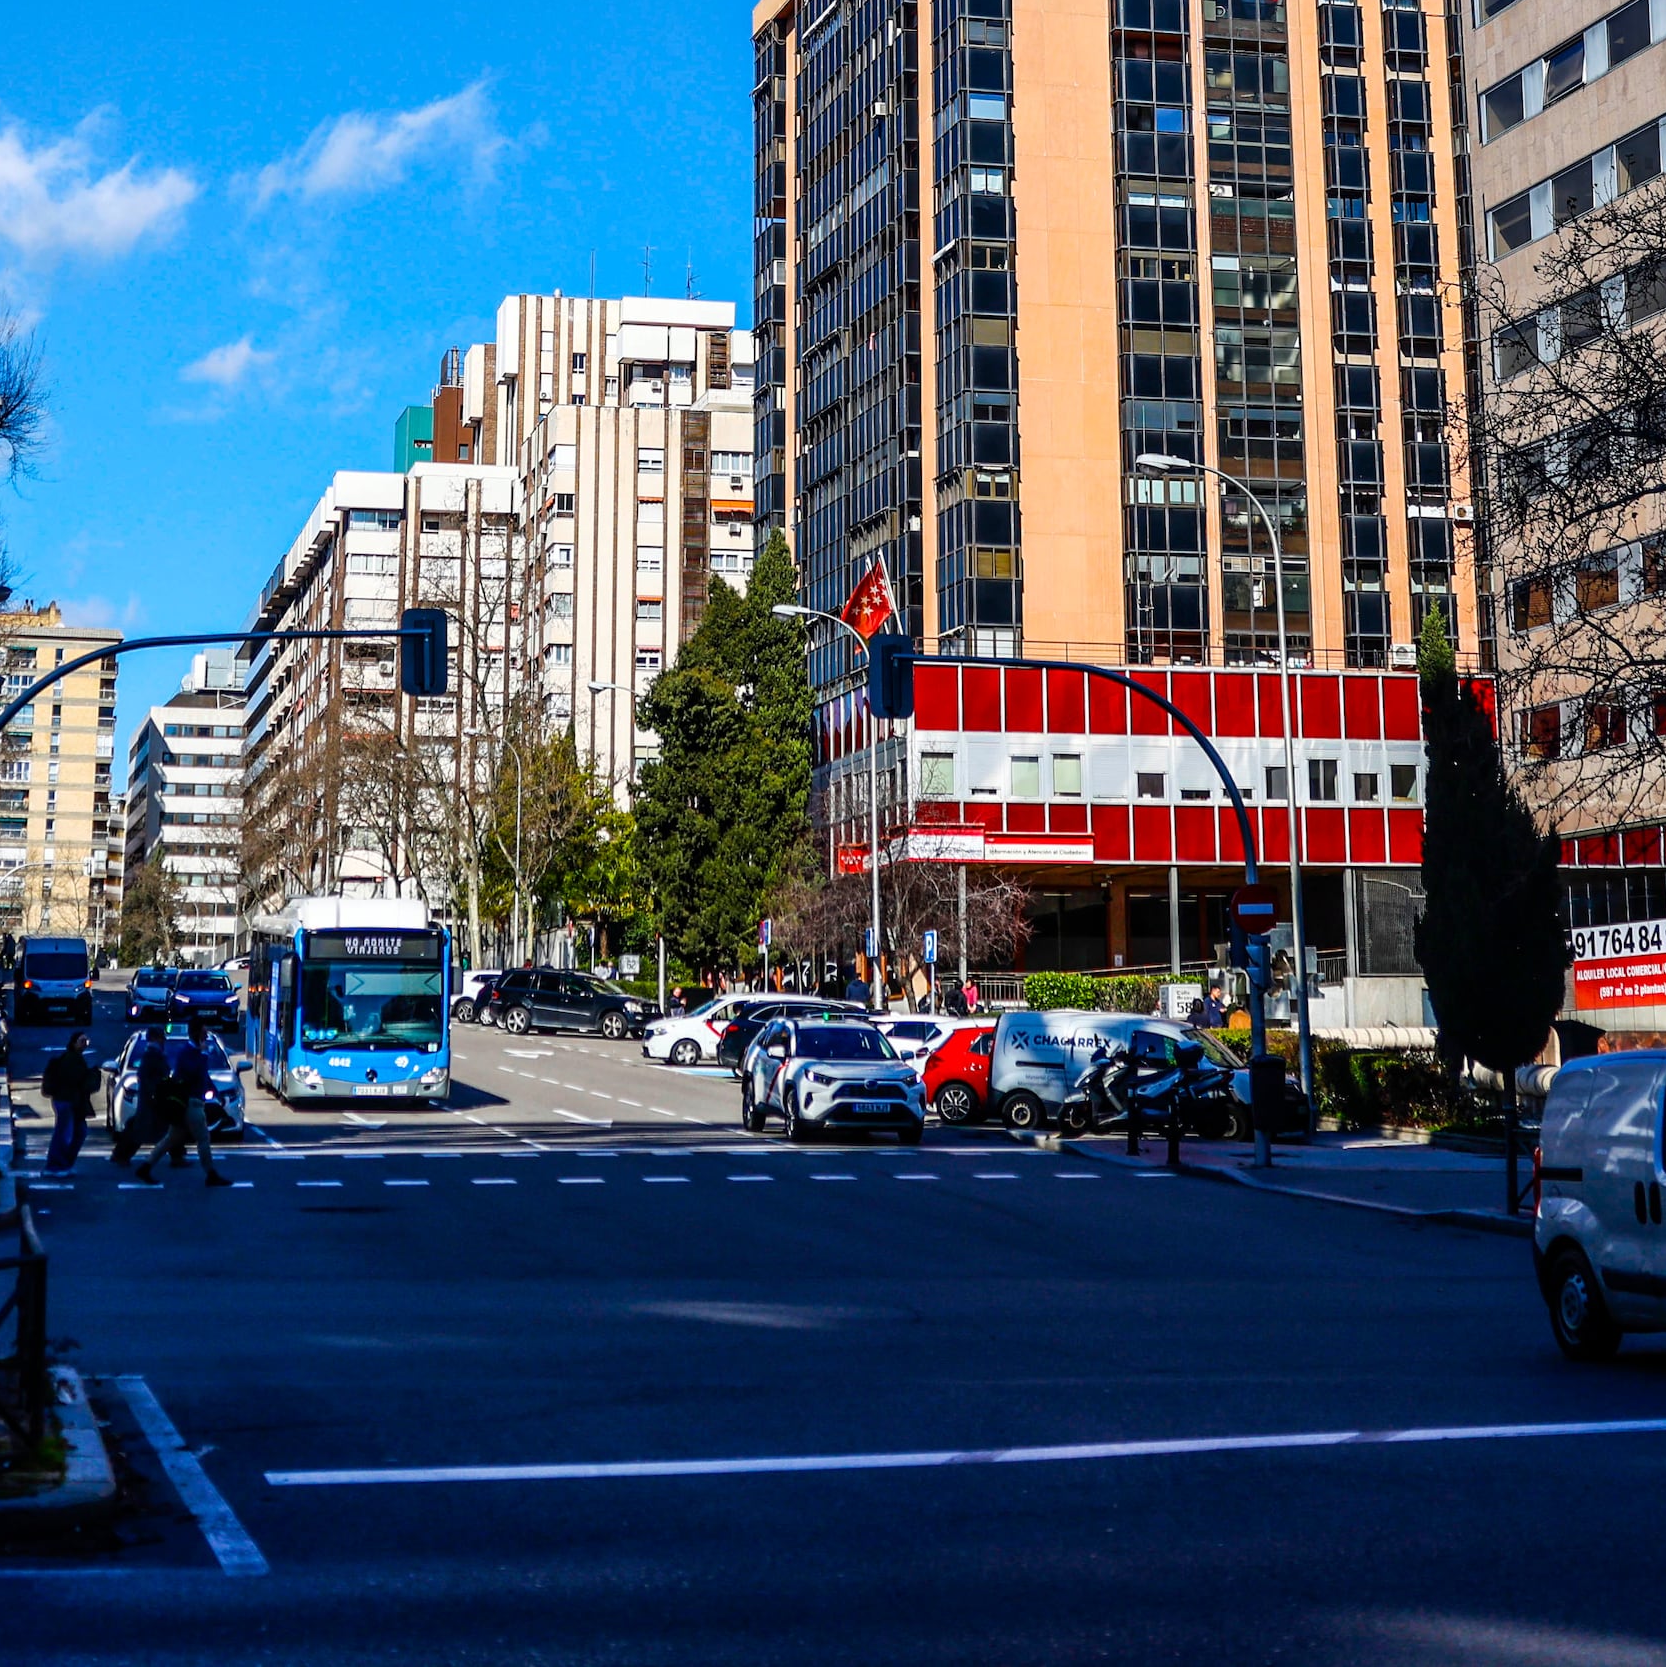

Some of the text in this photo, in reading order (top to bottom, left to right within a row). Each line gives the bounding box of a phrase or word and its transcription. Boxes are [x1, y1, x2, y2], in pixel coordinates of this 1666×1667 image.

[345, 936, 402, 947] NO ADMITE
[346, 946, 400, 955] VIAJEROS
[1576, 967, 1605, 981] ALQUILER
[1606, 966, 1626, 979] LOCAL
[1177, 1002, 1193, 1013] 58
